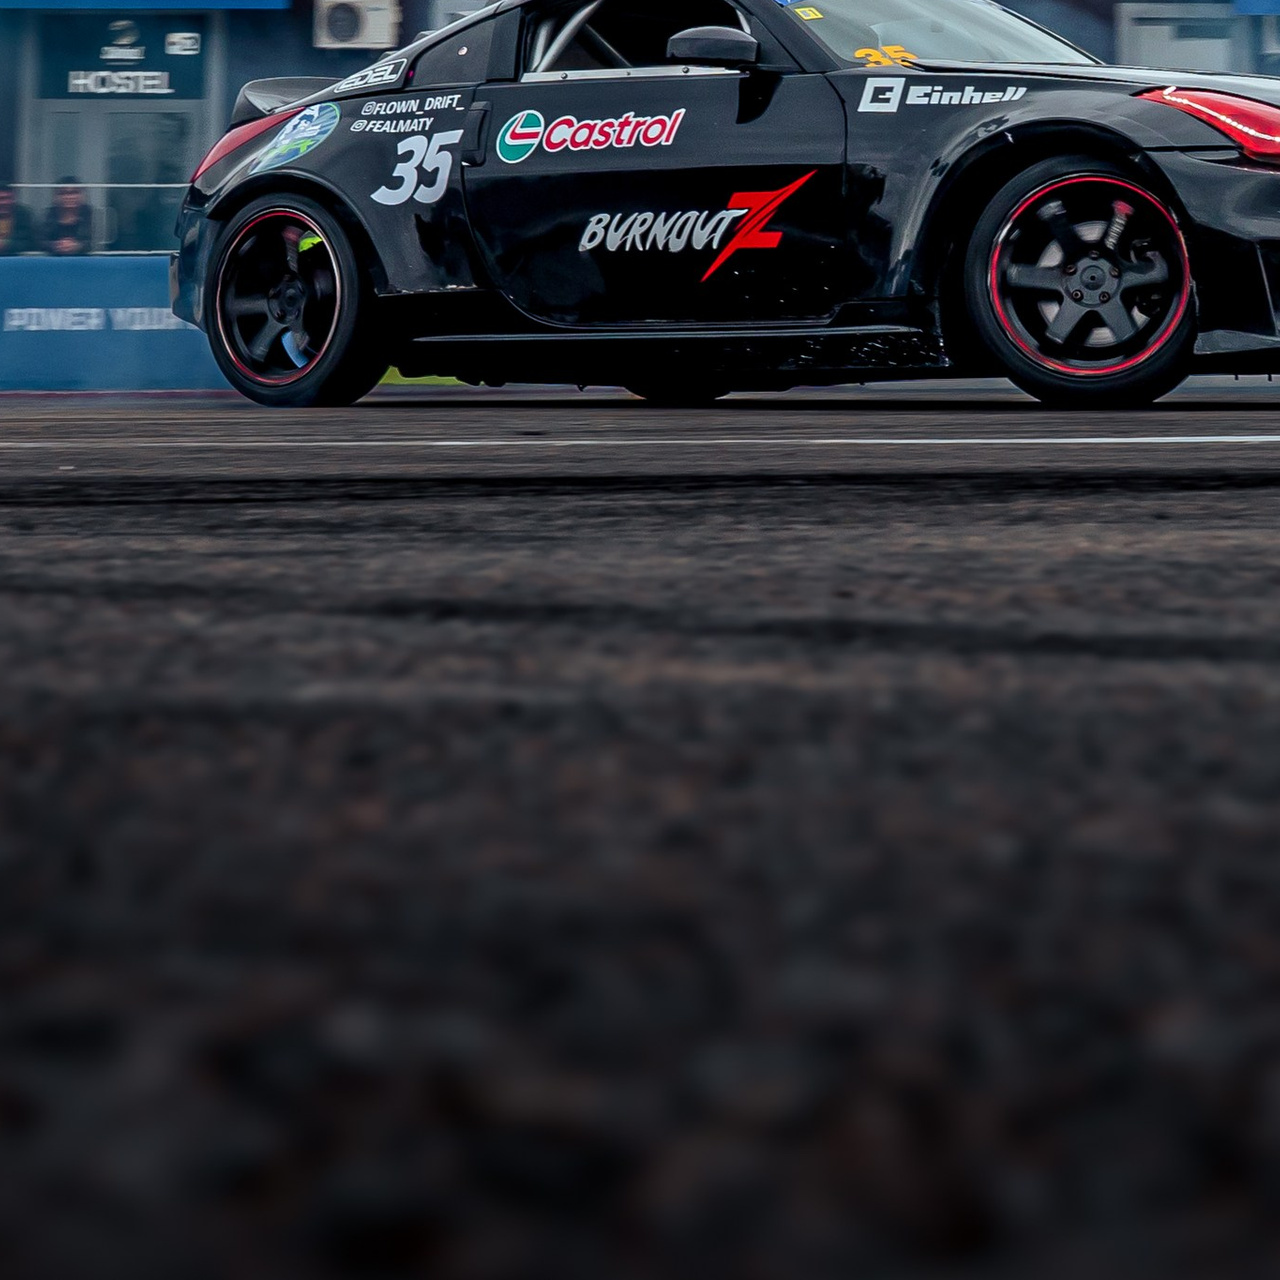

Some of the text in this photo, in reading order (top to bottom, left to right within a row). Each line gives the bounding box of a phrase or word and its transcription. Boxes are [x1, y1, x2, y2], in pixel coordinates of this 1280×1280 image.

[854, 44, 919, 68] 35
[905, 85, 1028, 106] Einhell
[543, 108, 686, 152] Castrol
[369, 129, 464, 206] 35
